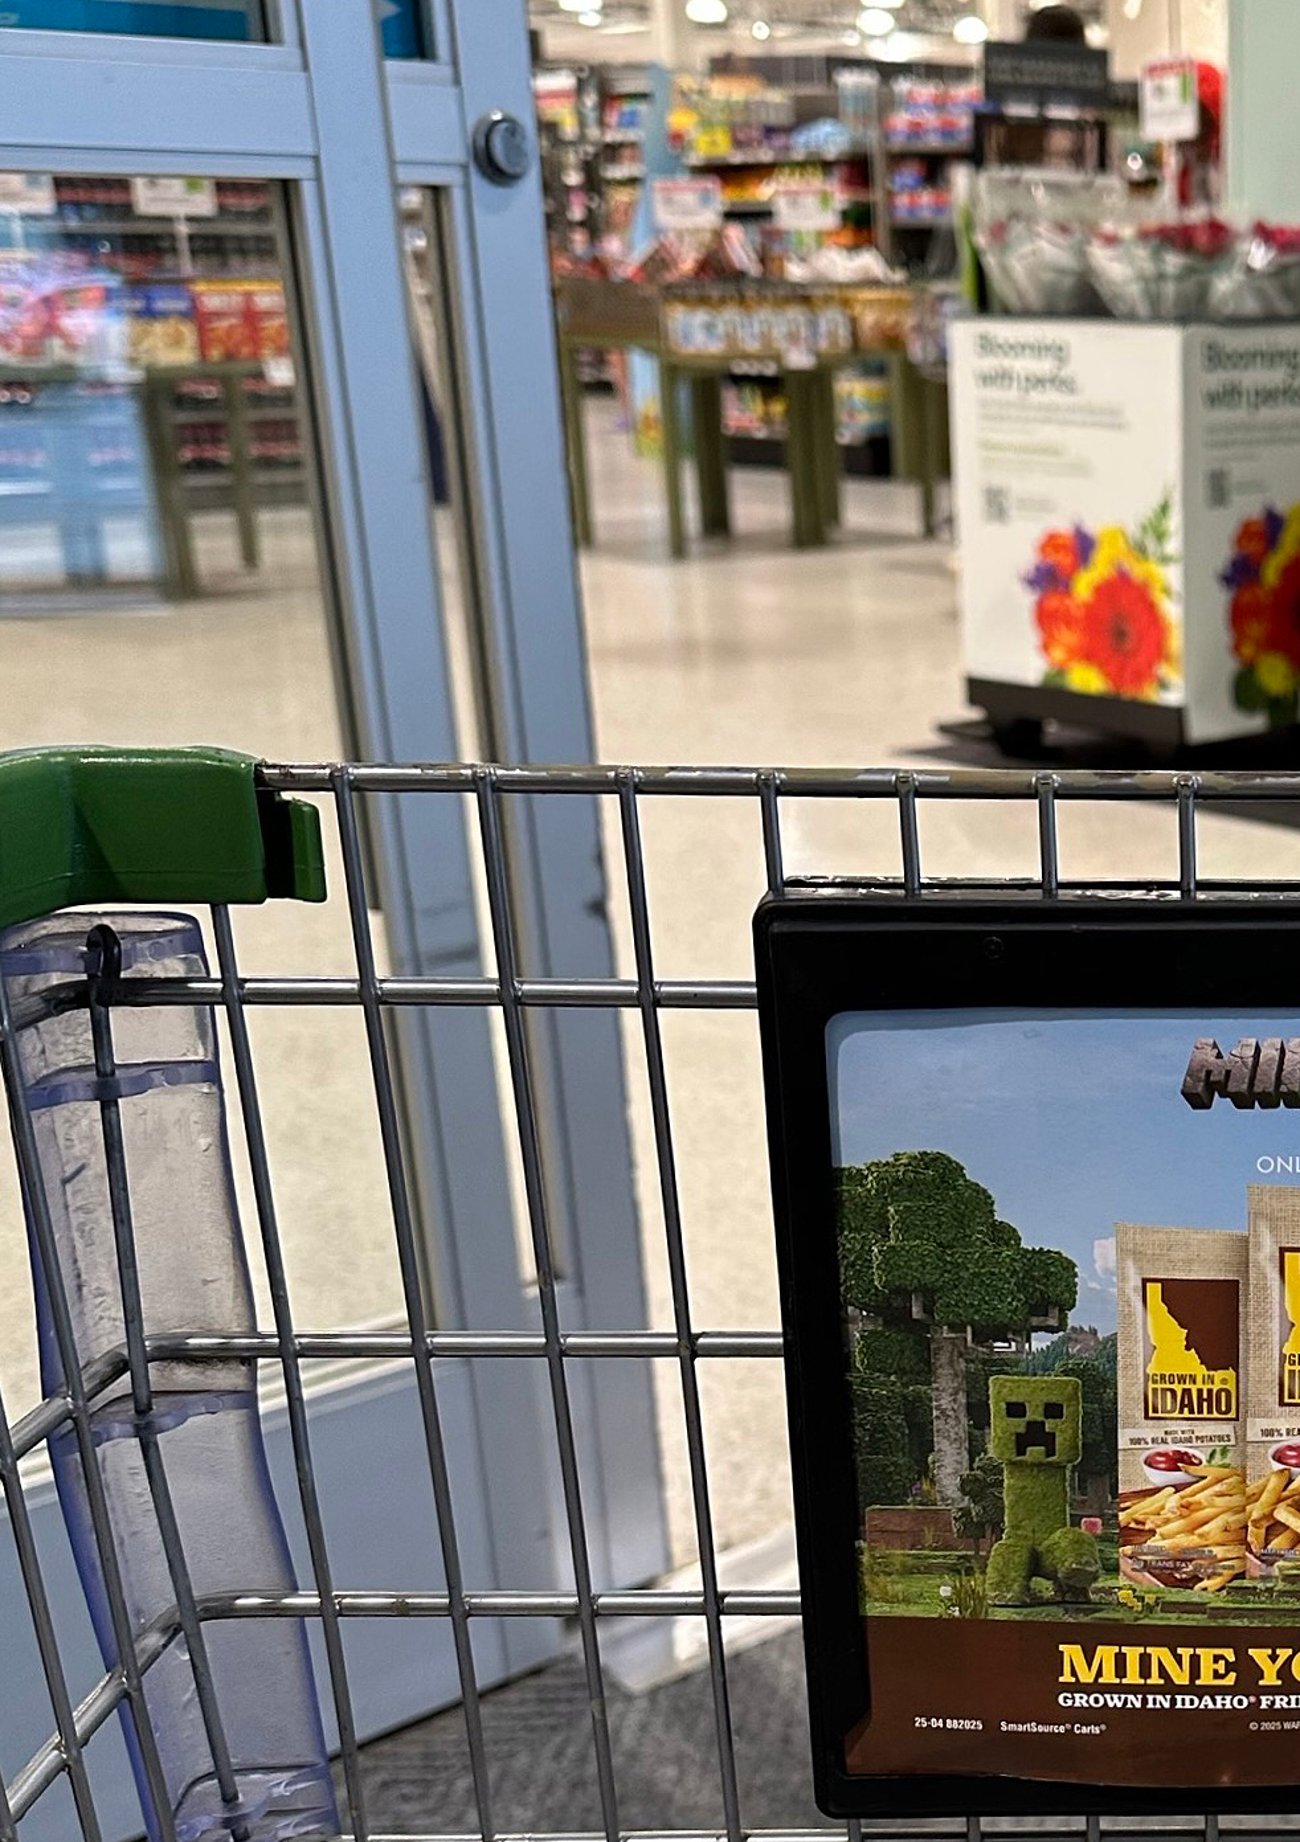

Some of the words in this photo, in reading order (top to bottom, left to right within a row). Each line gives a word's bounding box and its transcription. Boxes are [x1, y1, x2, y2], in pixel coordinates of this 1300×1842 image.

[1151, 1373, 1197, 1385] GROWN
[1201, 1373, 1215, 1385] IN
[1151, 1387, 1233, 1416] IDAHO
[1195, 1433, 1232, 1443] POTATOES
[1260, 1428, 1283, 1438] 100%
[1057, 1644, 1237, 1686] MINE
[1057, 1692, 1143, 1709] GROWN
[1145, 1693, 1172, 1709] IN
[914, 1716, 944, 1728] 25-04
[1260, 1721, 1282, 1731] 2025
